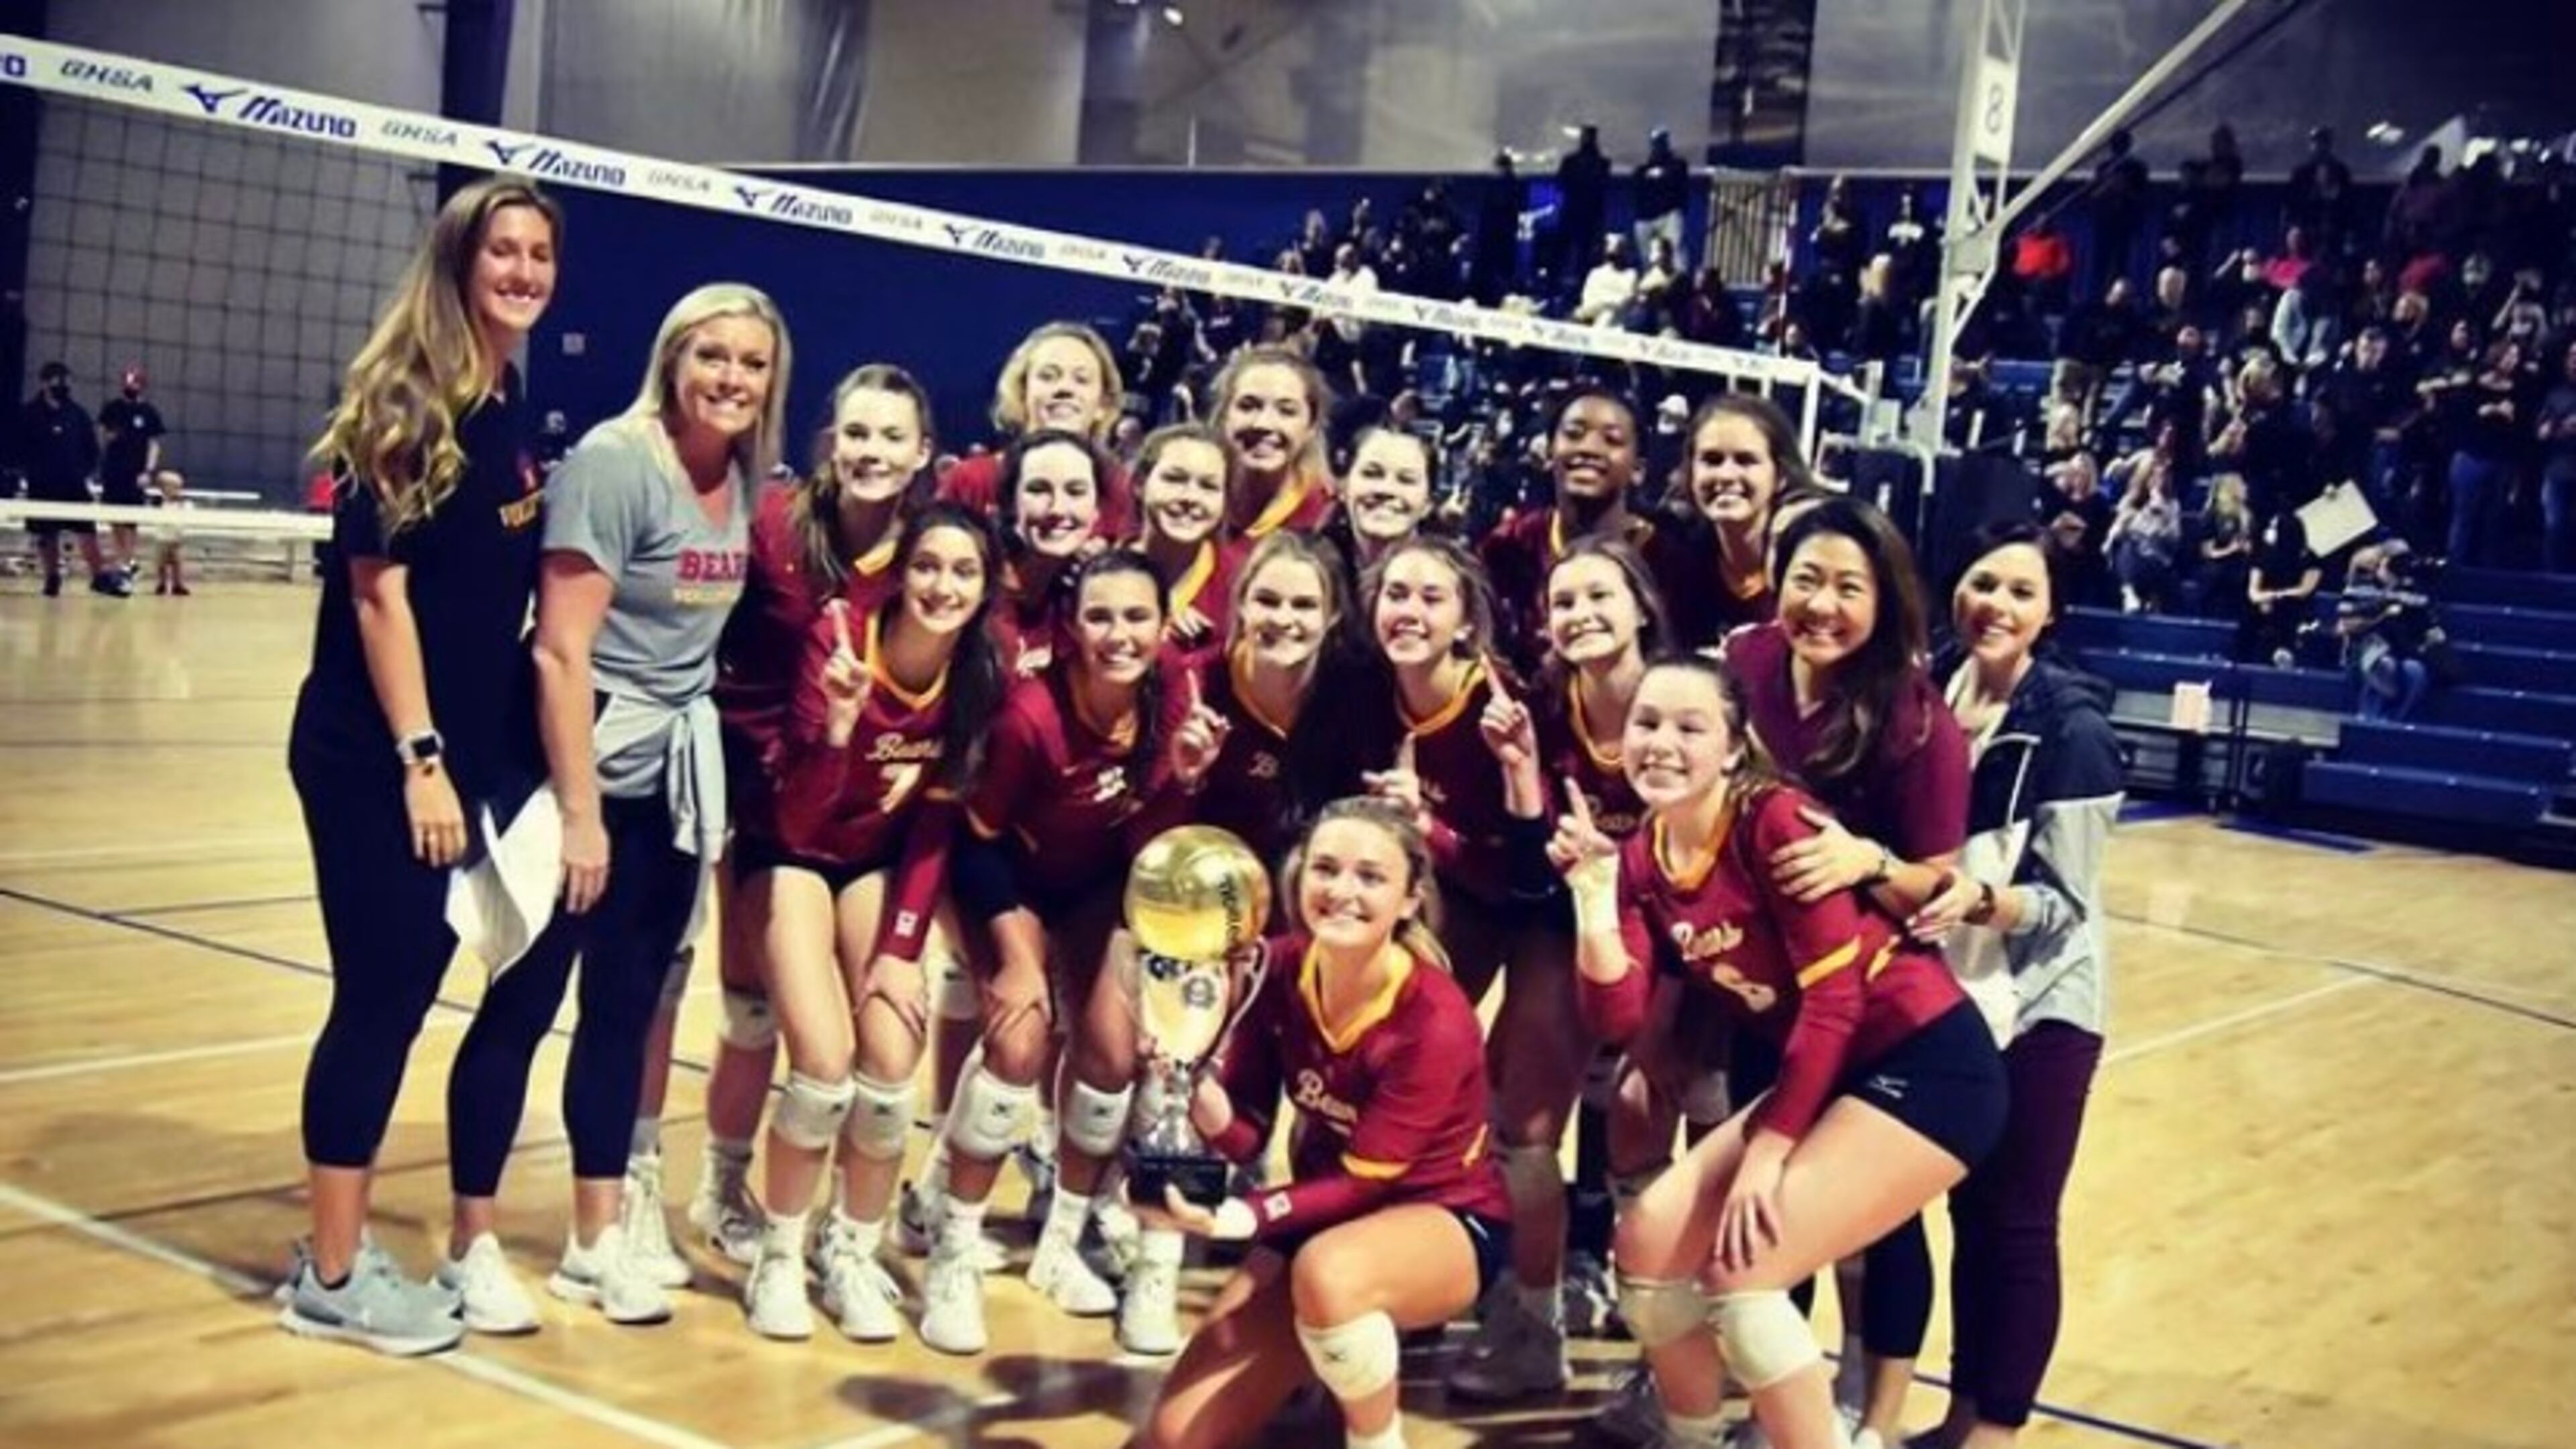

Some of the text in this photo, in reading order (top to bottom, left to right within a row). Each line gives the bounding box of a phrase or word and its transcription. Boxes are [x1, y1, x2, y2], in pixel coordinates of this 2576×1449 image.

[60, 58, 154, 92] GHSA
[1985, 83, 2004, 134] 8
[880, 763, 922, 814] 7
